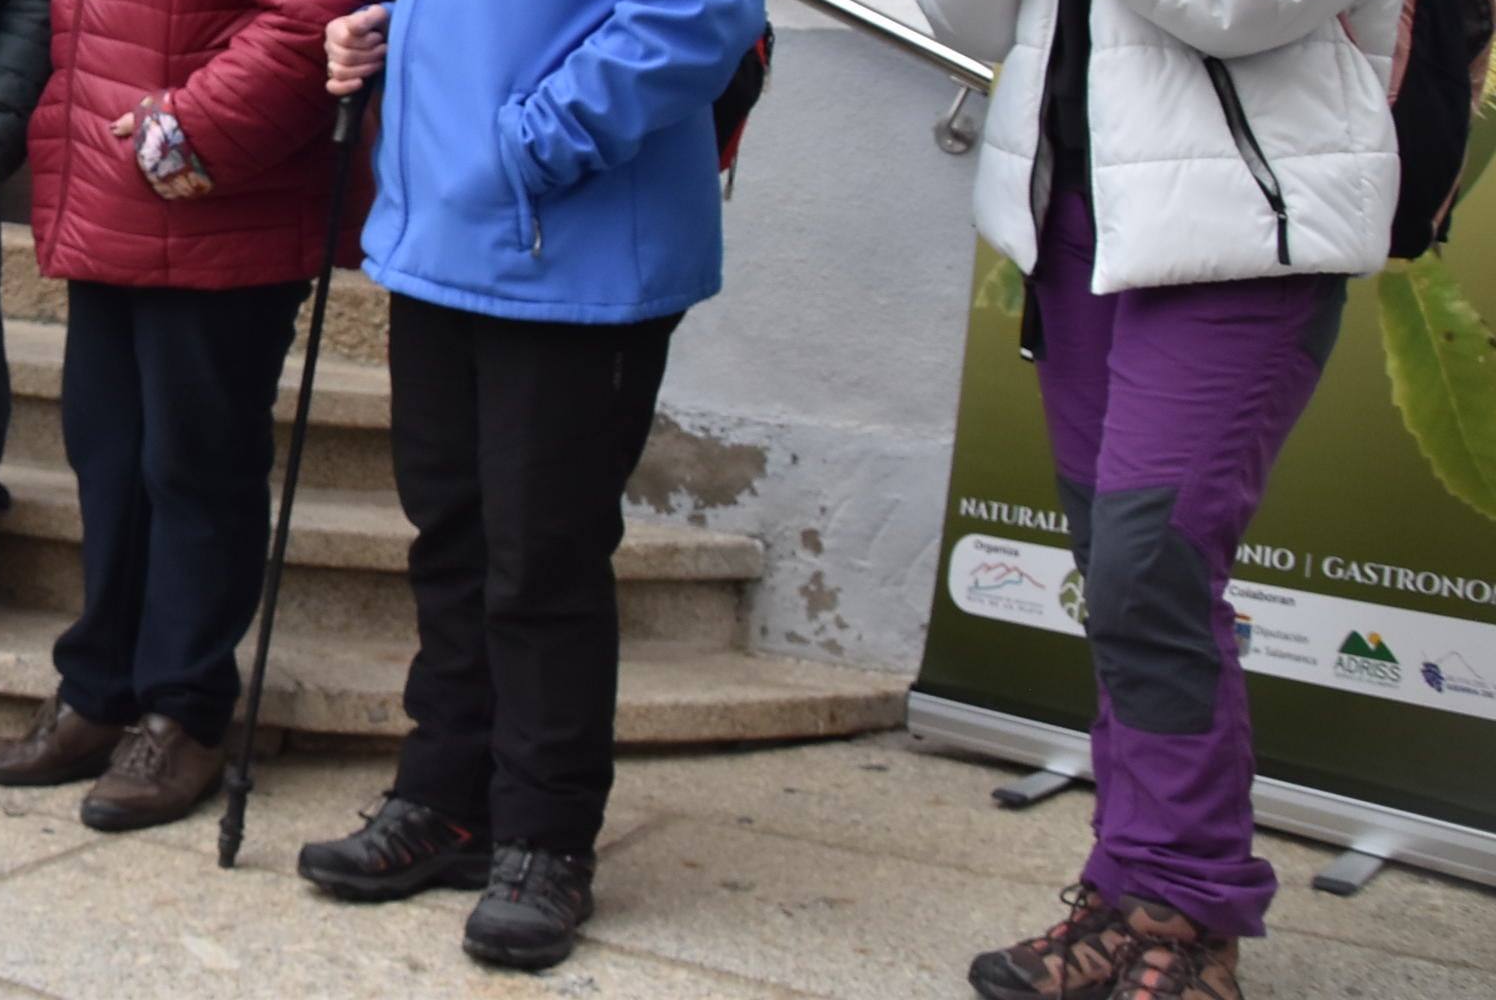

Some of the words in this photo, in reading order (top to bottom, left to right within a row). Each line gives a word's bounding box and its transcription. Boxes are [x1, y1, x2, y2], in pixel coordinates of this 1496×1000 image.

[974, 539, 1020, 557] Organiza
[1235, 543, 1296, 571] NIO
[1322, 555, 1496, 606] GASTRONO
[1229, 585, 1297, 607] Colaboran
[1333, 655, 1403, 684] ADRISS
